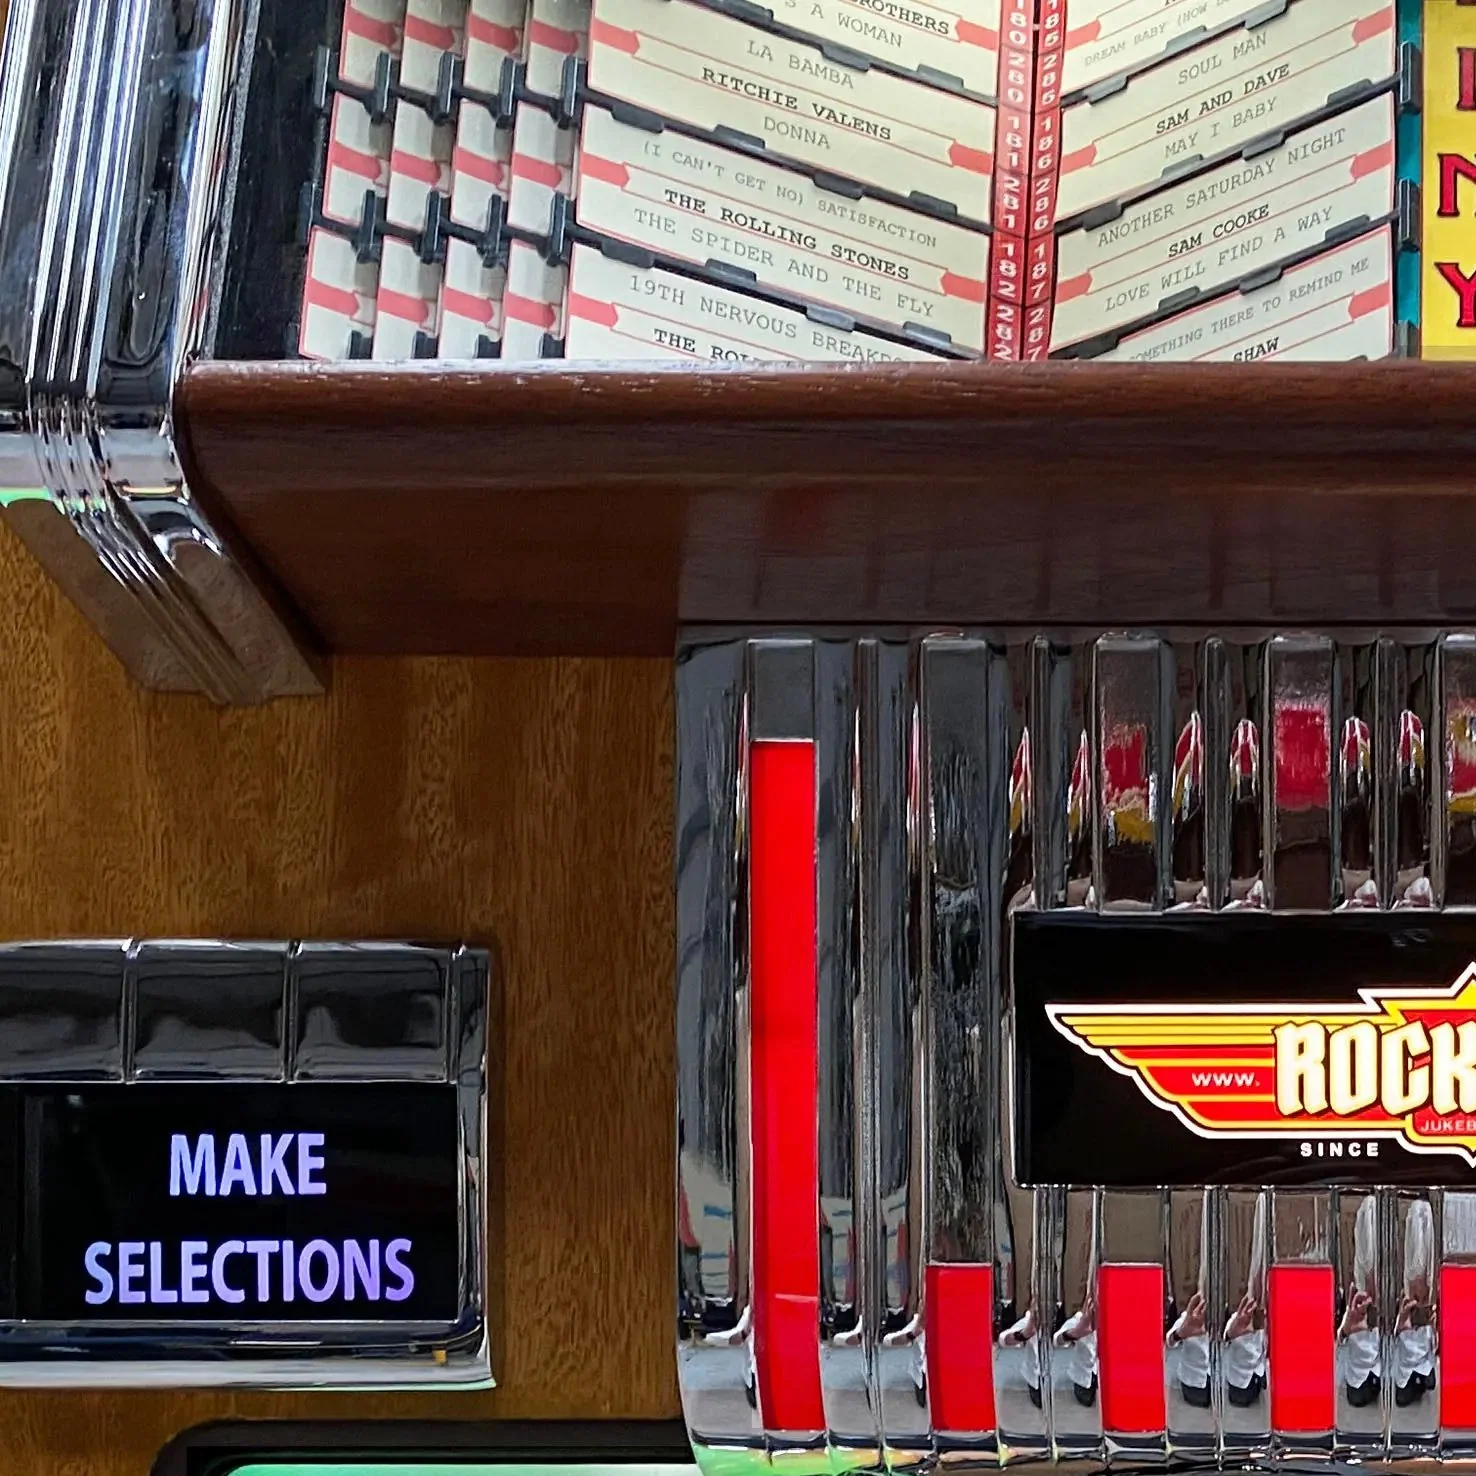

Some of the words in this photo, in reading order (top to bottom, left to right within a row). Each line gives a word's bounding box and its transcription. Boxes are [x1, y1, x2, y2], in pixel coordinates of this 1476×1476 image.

[810, 4, 824, 18] A
[838, 12, 902, 47] WOMAN
[850, 0, 949, 34] ROTHERS
[1084, 41, 1125, 67] DREAM
[1133, 23, 1167, 45] BABY
[747, 40, 774, 61] LA
[789, 54, 855, 88] BAMBA
[1178, 55, 1222, 86] SOUL
[1232, 32, 1267, 60] MAN
[702, 66, 798, 110] RITCHIE
[812, 103, 892, 140] VALENS
[1156, 108, 1190, 134] SAM
[1199, 90, 1233, 116] AND
[1244, 63, 1290, 95] DAVE
[1164, 132, 1199, 158] MAY
[1210, 123, 1221, 137] I
[1232, 97, 1278, 128] BABY
[764, 117, 831, 150] DONNA
[643, 140, 661, 157] (I
[672, 151, 726, 178] CAN'T
[735, 172, 766, 191] GET
[776, 185, 804, 205] NO)
[817, 200, 937, 248] SATISFACTION
[1098, 206, 1175, 247] ANOTHER
[1185, 157, 1277, 210] SATURDAY
[1288, 128, 1347, 165] NIGHT
[665, 189, 706, 215] THE
[720, 207, 817, 250] ROLLING
[831, 244, 910, 281] STONES
[1105, 282, 1150, 312] LOVE
[1160, 260, 1205, 290] WILL
[1217, 236, 1264, 266] FIND
[1274, 227, 1286, 243] A
[1297, 206, 1334, 232] WAY
[1168, 234, 1203, 258] SAM
[1212, 204, 1270, 238] COOKE
[634, 207, 677, 235] THE
[691, 228, 774, 267] SPIDER
[788, 258, 829, 283] AND
[843, 276, 882, 301] THE
[897, 294, 936, 318] FLY
[629, 274, 685, 306] 19TH
[700, 295, 797, 339] NERVOUS
[1211, 307, 1254, 334] THERE
[1262, 295, 1281, 312] TO
[1289, 270, 1343, 302] REMIND
[1351, 257, 1370, 277] ME
[654, 328, 696, 353] THE
[1232, 337, 1280, 361] SHAW
[1191, 1072, 1261, 1087] www.
[169, 1132, 327, 1196] MAKE
[1300, 1142, 1379, 1157] SINCE
[84, 1239, 415, 1304] SELECTIONS
